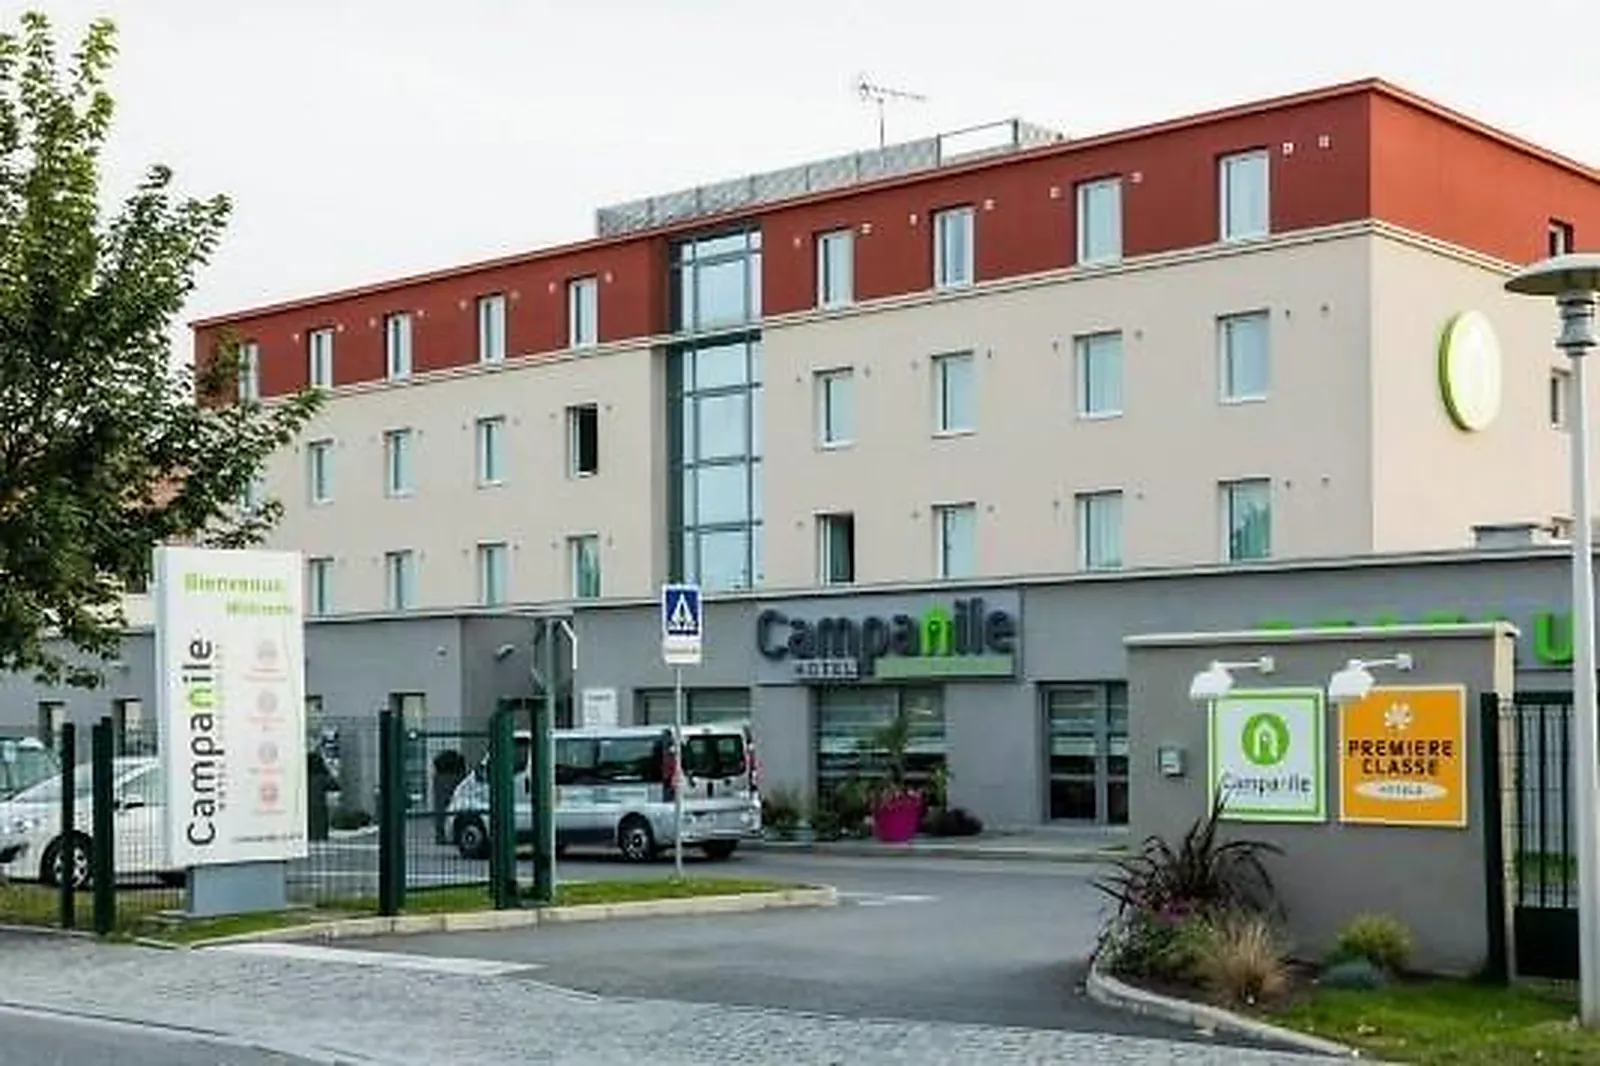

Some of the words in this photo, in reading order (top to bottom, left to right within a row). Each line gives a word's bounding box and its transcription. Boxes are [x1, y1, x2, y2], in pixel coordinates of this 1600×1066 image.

[757, 597, 1015, 676] Campanile
[182, 637, 224, 847] Campanile
[1348, 740, 1453, 757] PREMIERE
[1362, 759, 1439, 776] CLASSE
